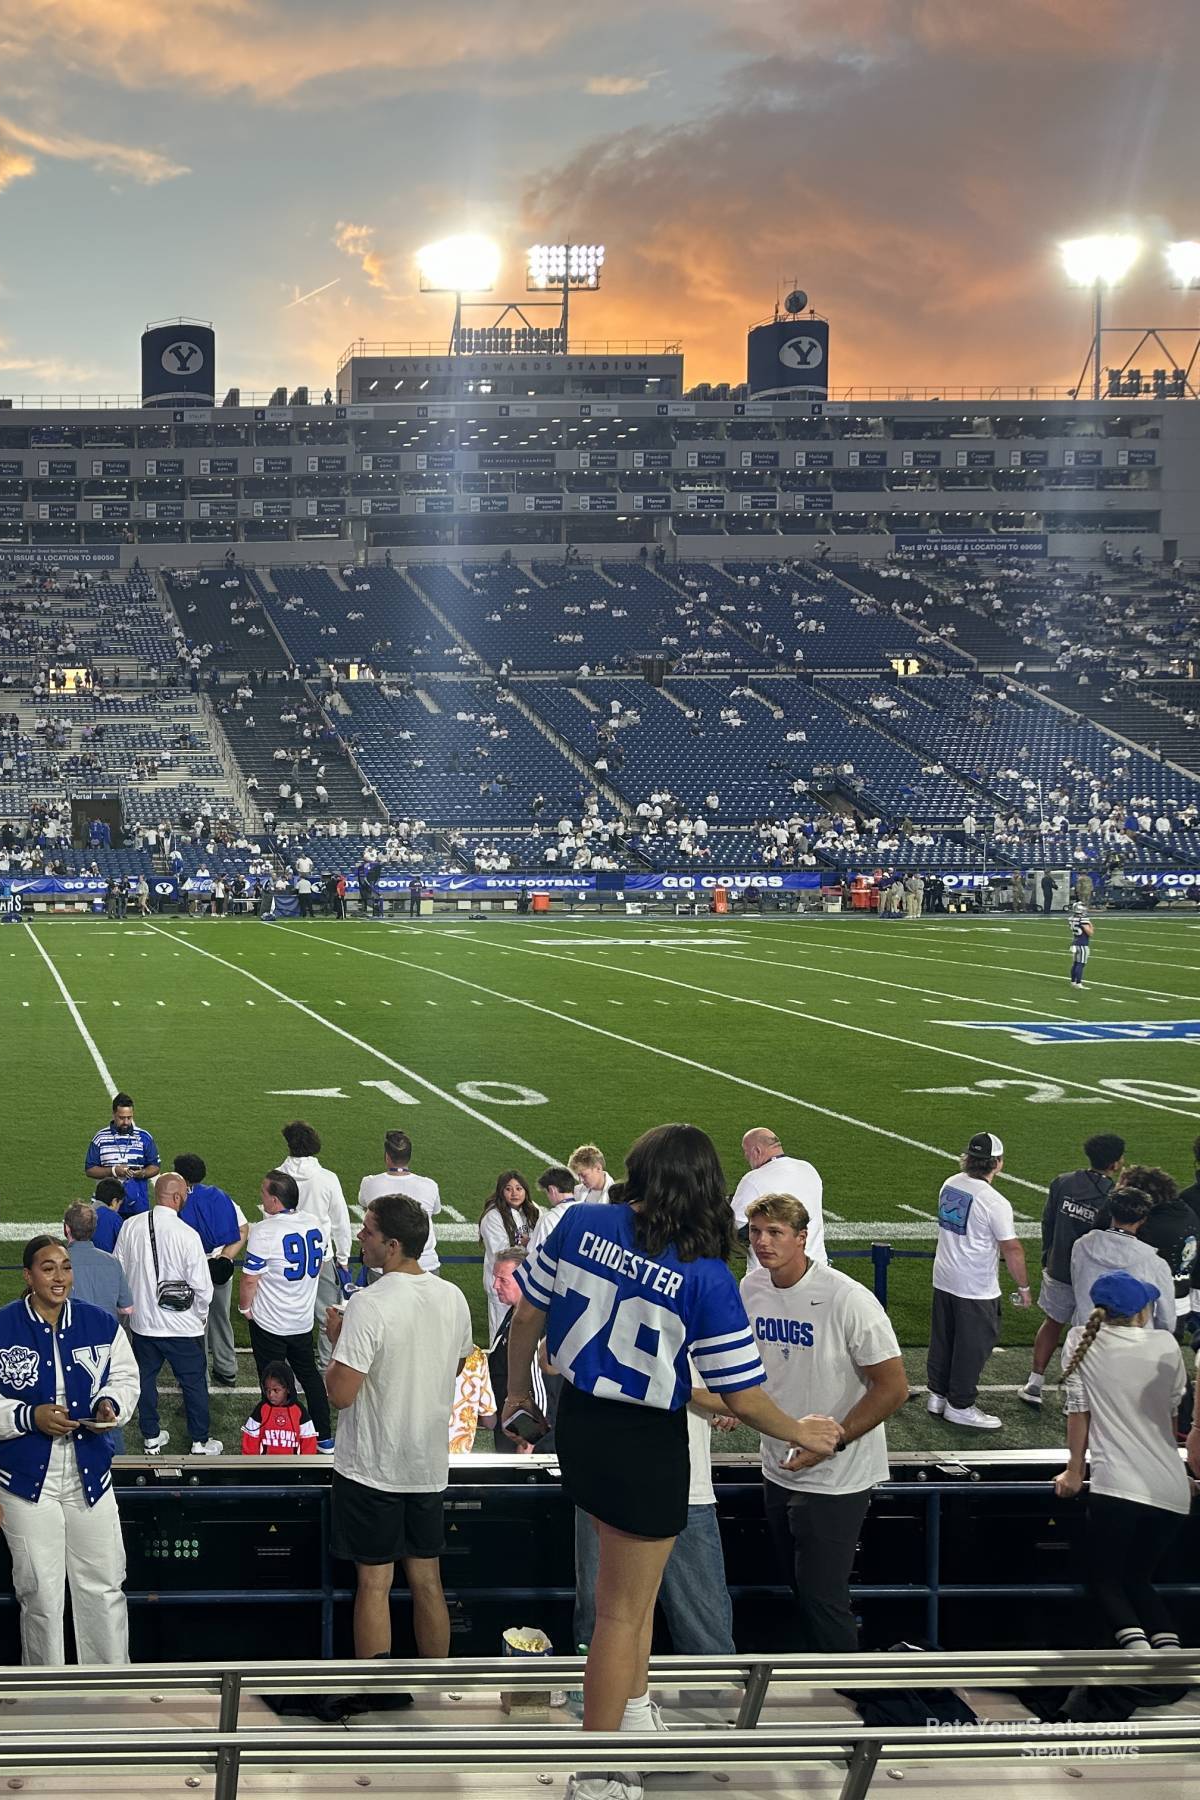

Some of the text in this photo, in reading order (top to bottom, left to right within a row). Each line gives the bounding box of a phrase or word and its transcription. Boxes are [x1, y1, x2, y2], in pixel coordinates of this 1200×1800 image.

[567, 361, 648, 371] STADIUM
[63, 881, 85, 889] GO
[486, 879, 516, 887] BYU
[662, 876, 783, 889] GO COUGS
[1062, 1200, 1096, 1221] POWER
[282, 1228, 323, 1282] 96
[578, 1231, 684, 1299] CHIDESTER
[551, 1258, 687, 1411] 79
[755, 1316, 814, 1347] COUGS
[71, 1344, 111, 1398] Y
